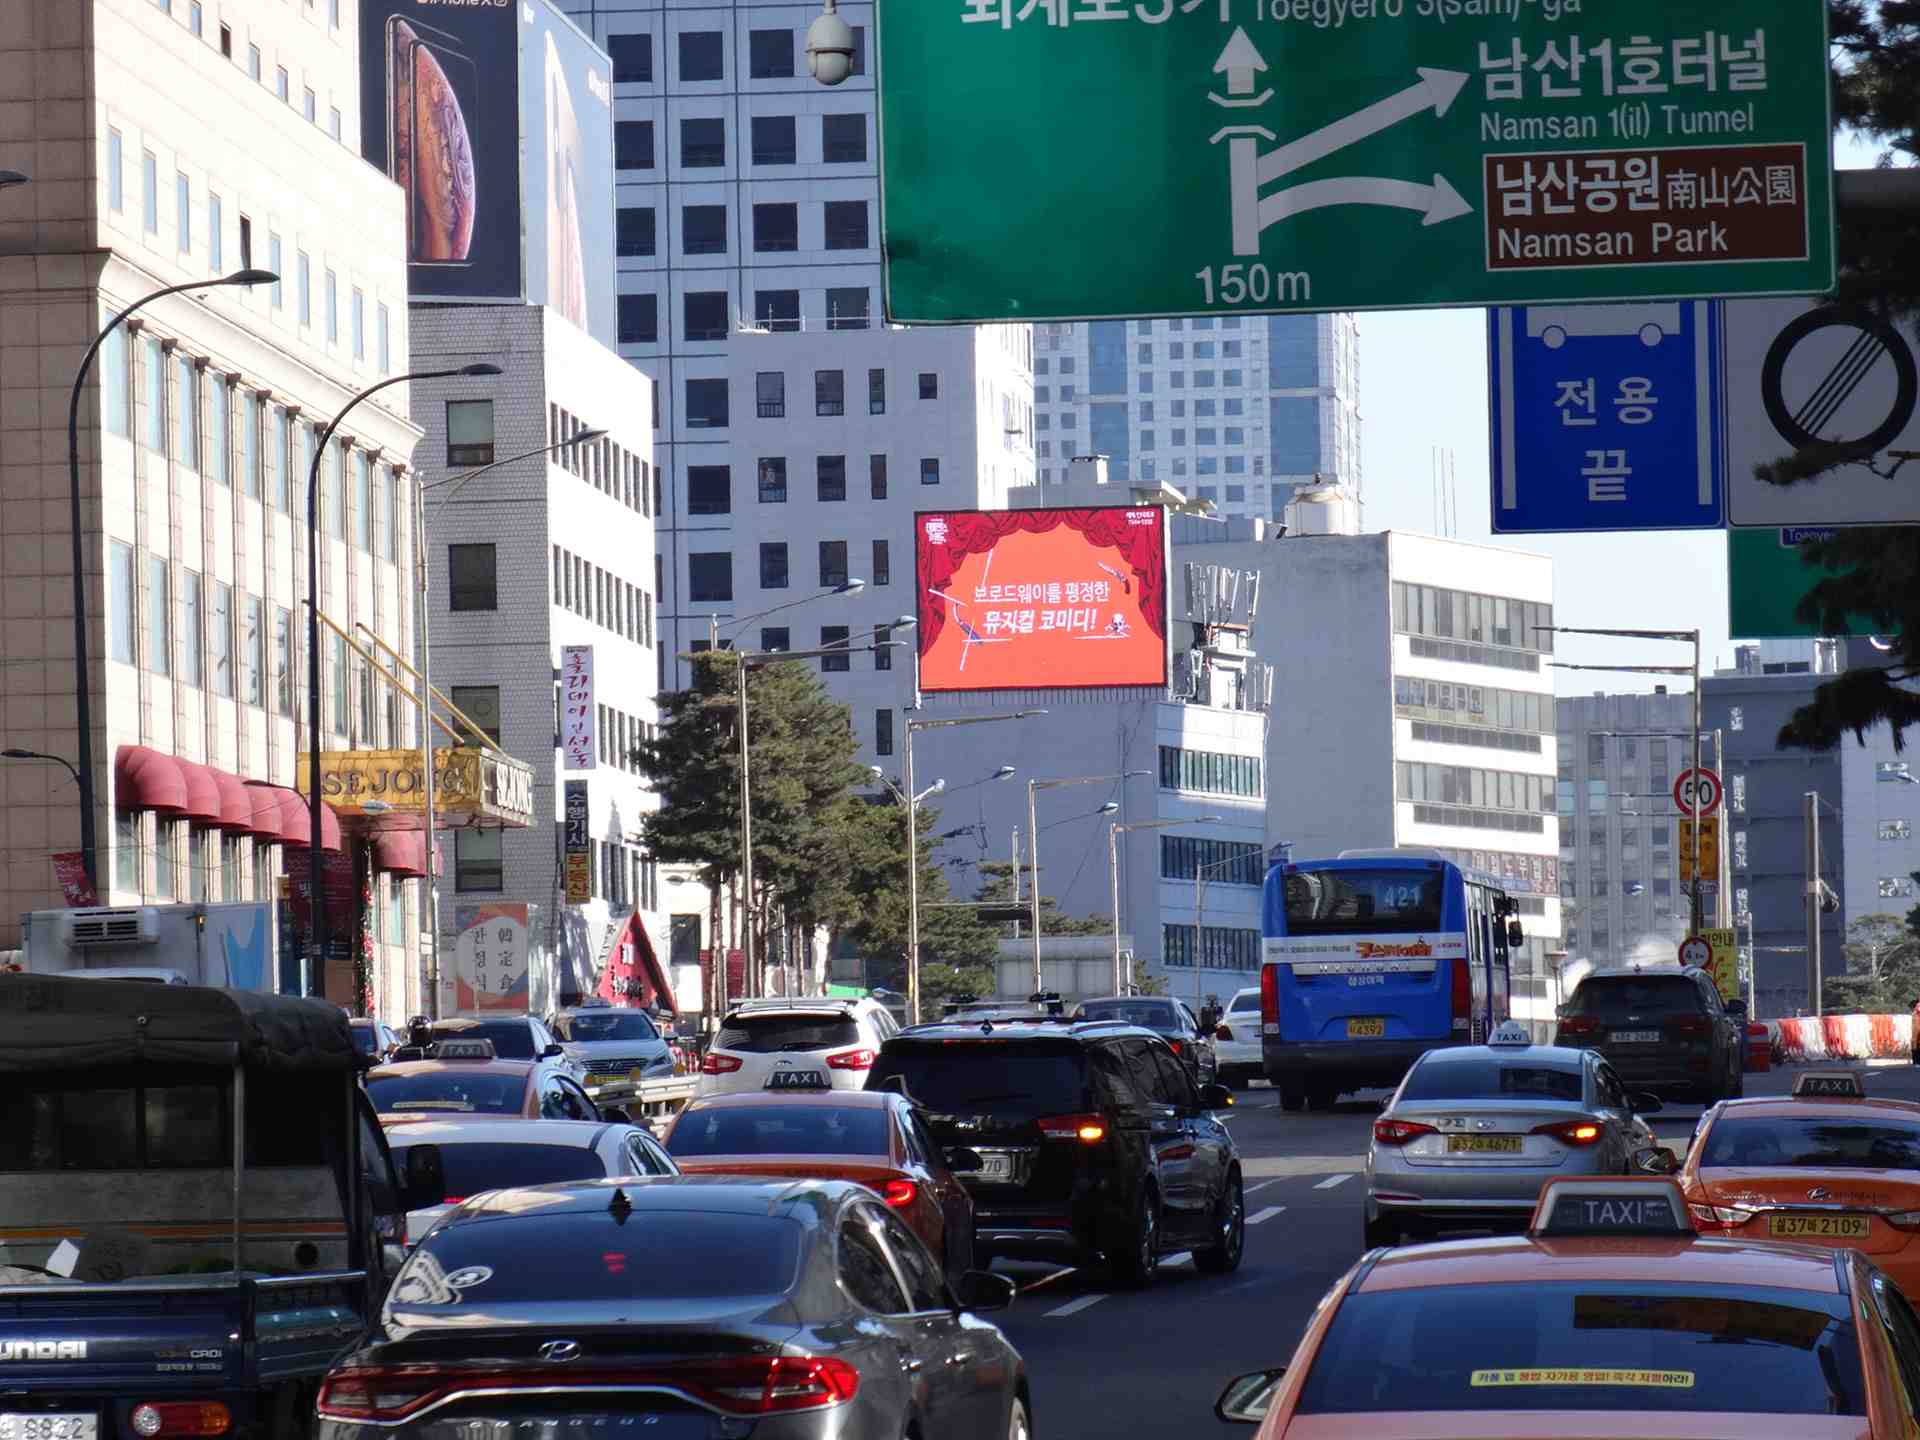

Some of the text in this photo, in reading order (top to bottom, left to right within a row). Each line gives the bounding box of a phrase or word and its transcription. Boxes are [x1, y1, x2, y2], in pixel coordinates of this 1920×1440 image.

[1478, 28, 1768, 100] 남산1호터널
[1480, 101, 1754, 141] Namsan 1(il) Tunnel
[1496, 156, 1797, 216] 남산공원 南山公園
[1499, 220, 1729, 259] Namsan Park
[1580, 449, 1633, 501] 끝
[974, 580, 1111, 604] 브로드웨이를 평정한
[983, 607, 1098, 634] 뮤지컬 코미디!
[1383, 886, 1421, 907] 421
[1497, 1033, 1523, 1041] TAXI
[447, 1046, 480, 1057] TAXI
[777, 1072, 817, 1085] TAXI
[1808, 1080, 1850, 1091] TAXI
[1584, 1200, 1642, 1224] TAXI
[1822, 1216, 1862, 1234] 2109
